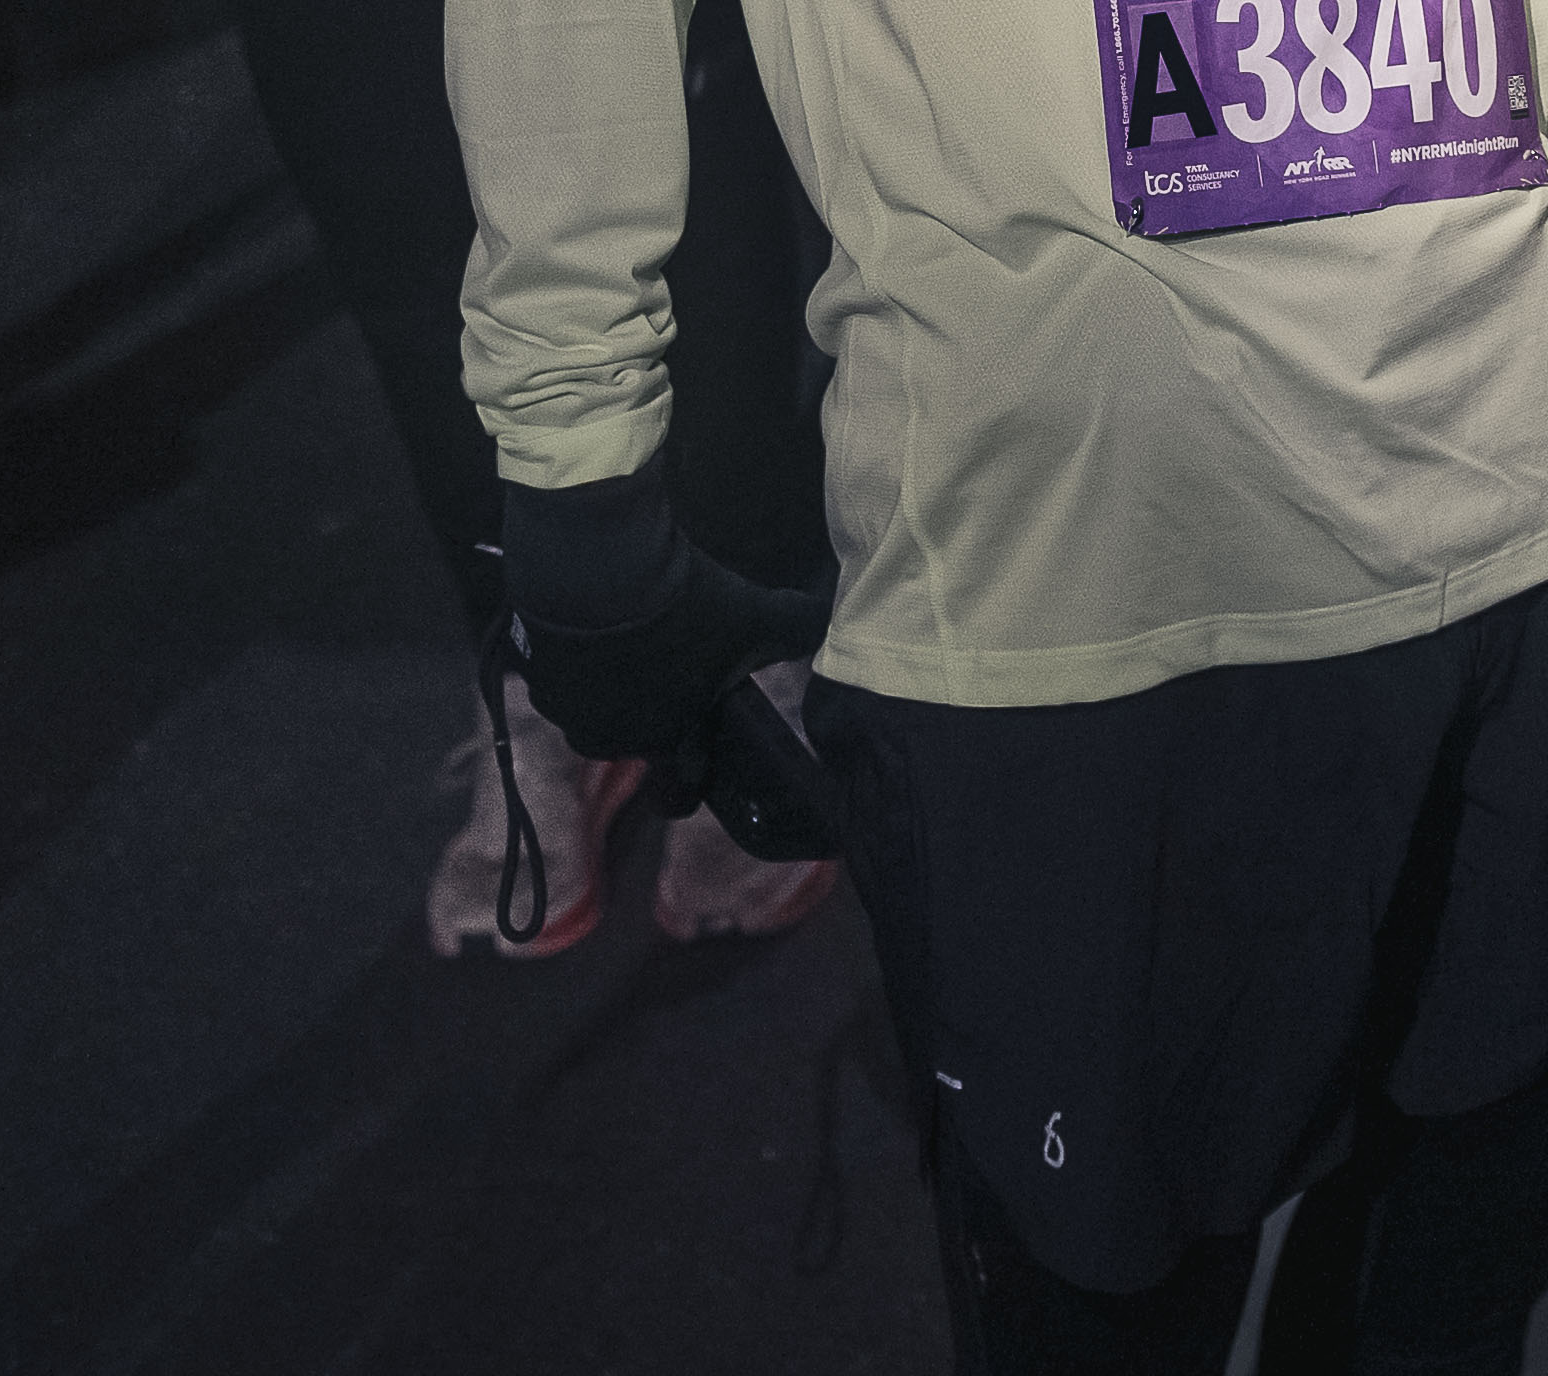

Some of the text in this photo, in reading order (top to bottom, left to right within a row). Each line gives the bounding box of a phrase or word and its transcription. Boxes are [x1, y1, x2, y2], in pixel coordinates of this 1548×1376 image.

[1116, 54, 1126, 71] call
[1119, 71, 1131, 125] Emergency,
[1125, 149, 1134, 167] For
[1185, 163, 1210, 173] TATA
[1186, 169, 1240, 183] CONSULTANCY
[1144, 170, 1184, 196] tcs
[1187, 180, 1223, 192] SERVICES
